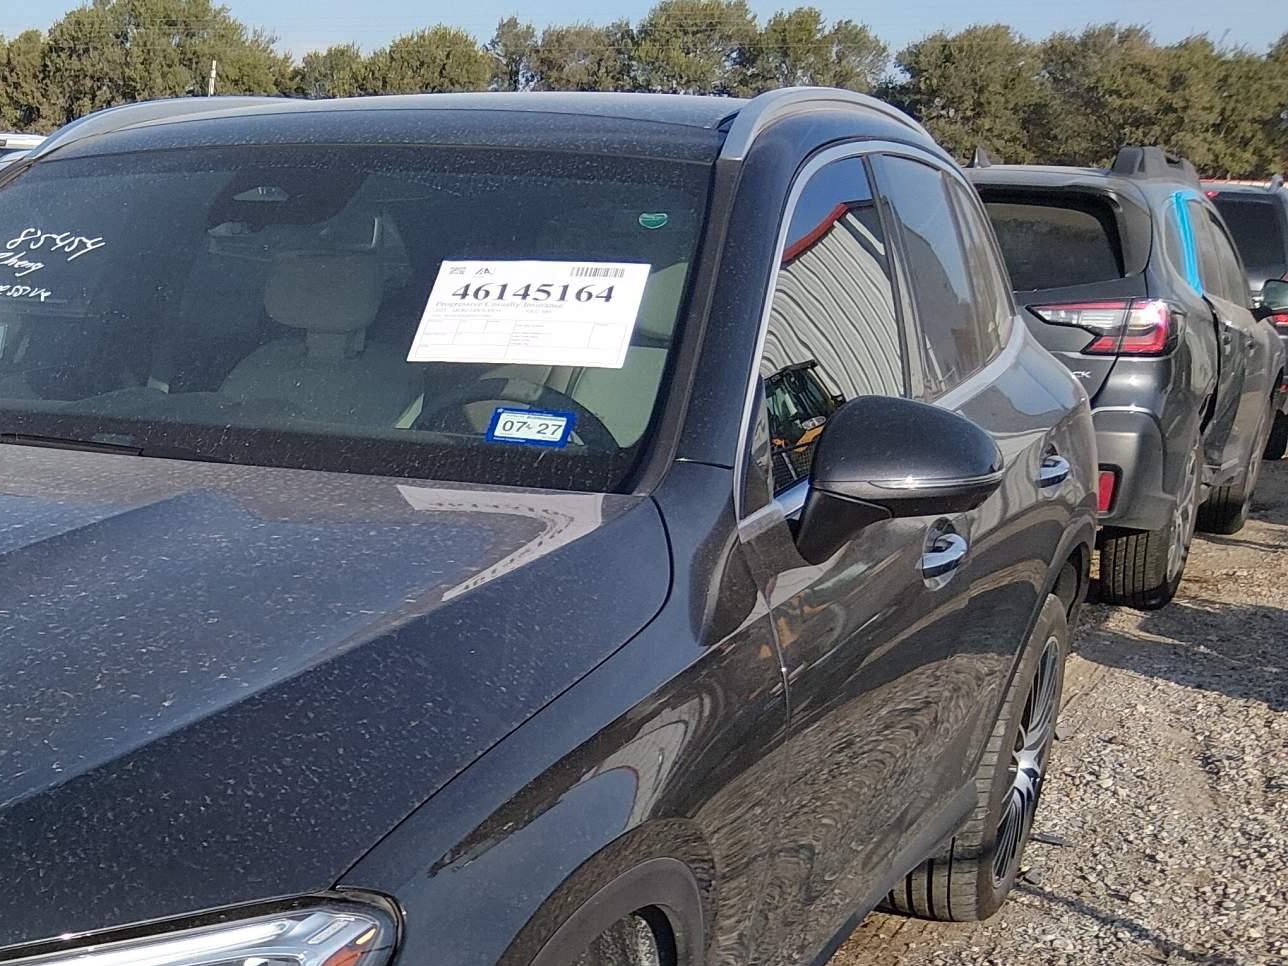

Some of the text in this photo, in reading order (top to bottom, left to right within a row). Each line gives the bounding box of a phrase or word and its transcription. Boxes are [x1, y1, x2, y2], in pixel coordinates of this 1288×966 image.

[5, 227, 106, 261] 85454
[451, 282, 615, 302] 46145164
[502, 420, 562, 435] 07 27
